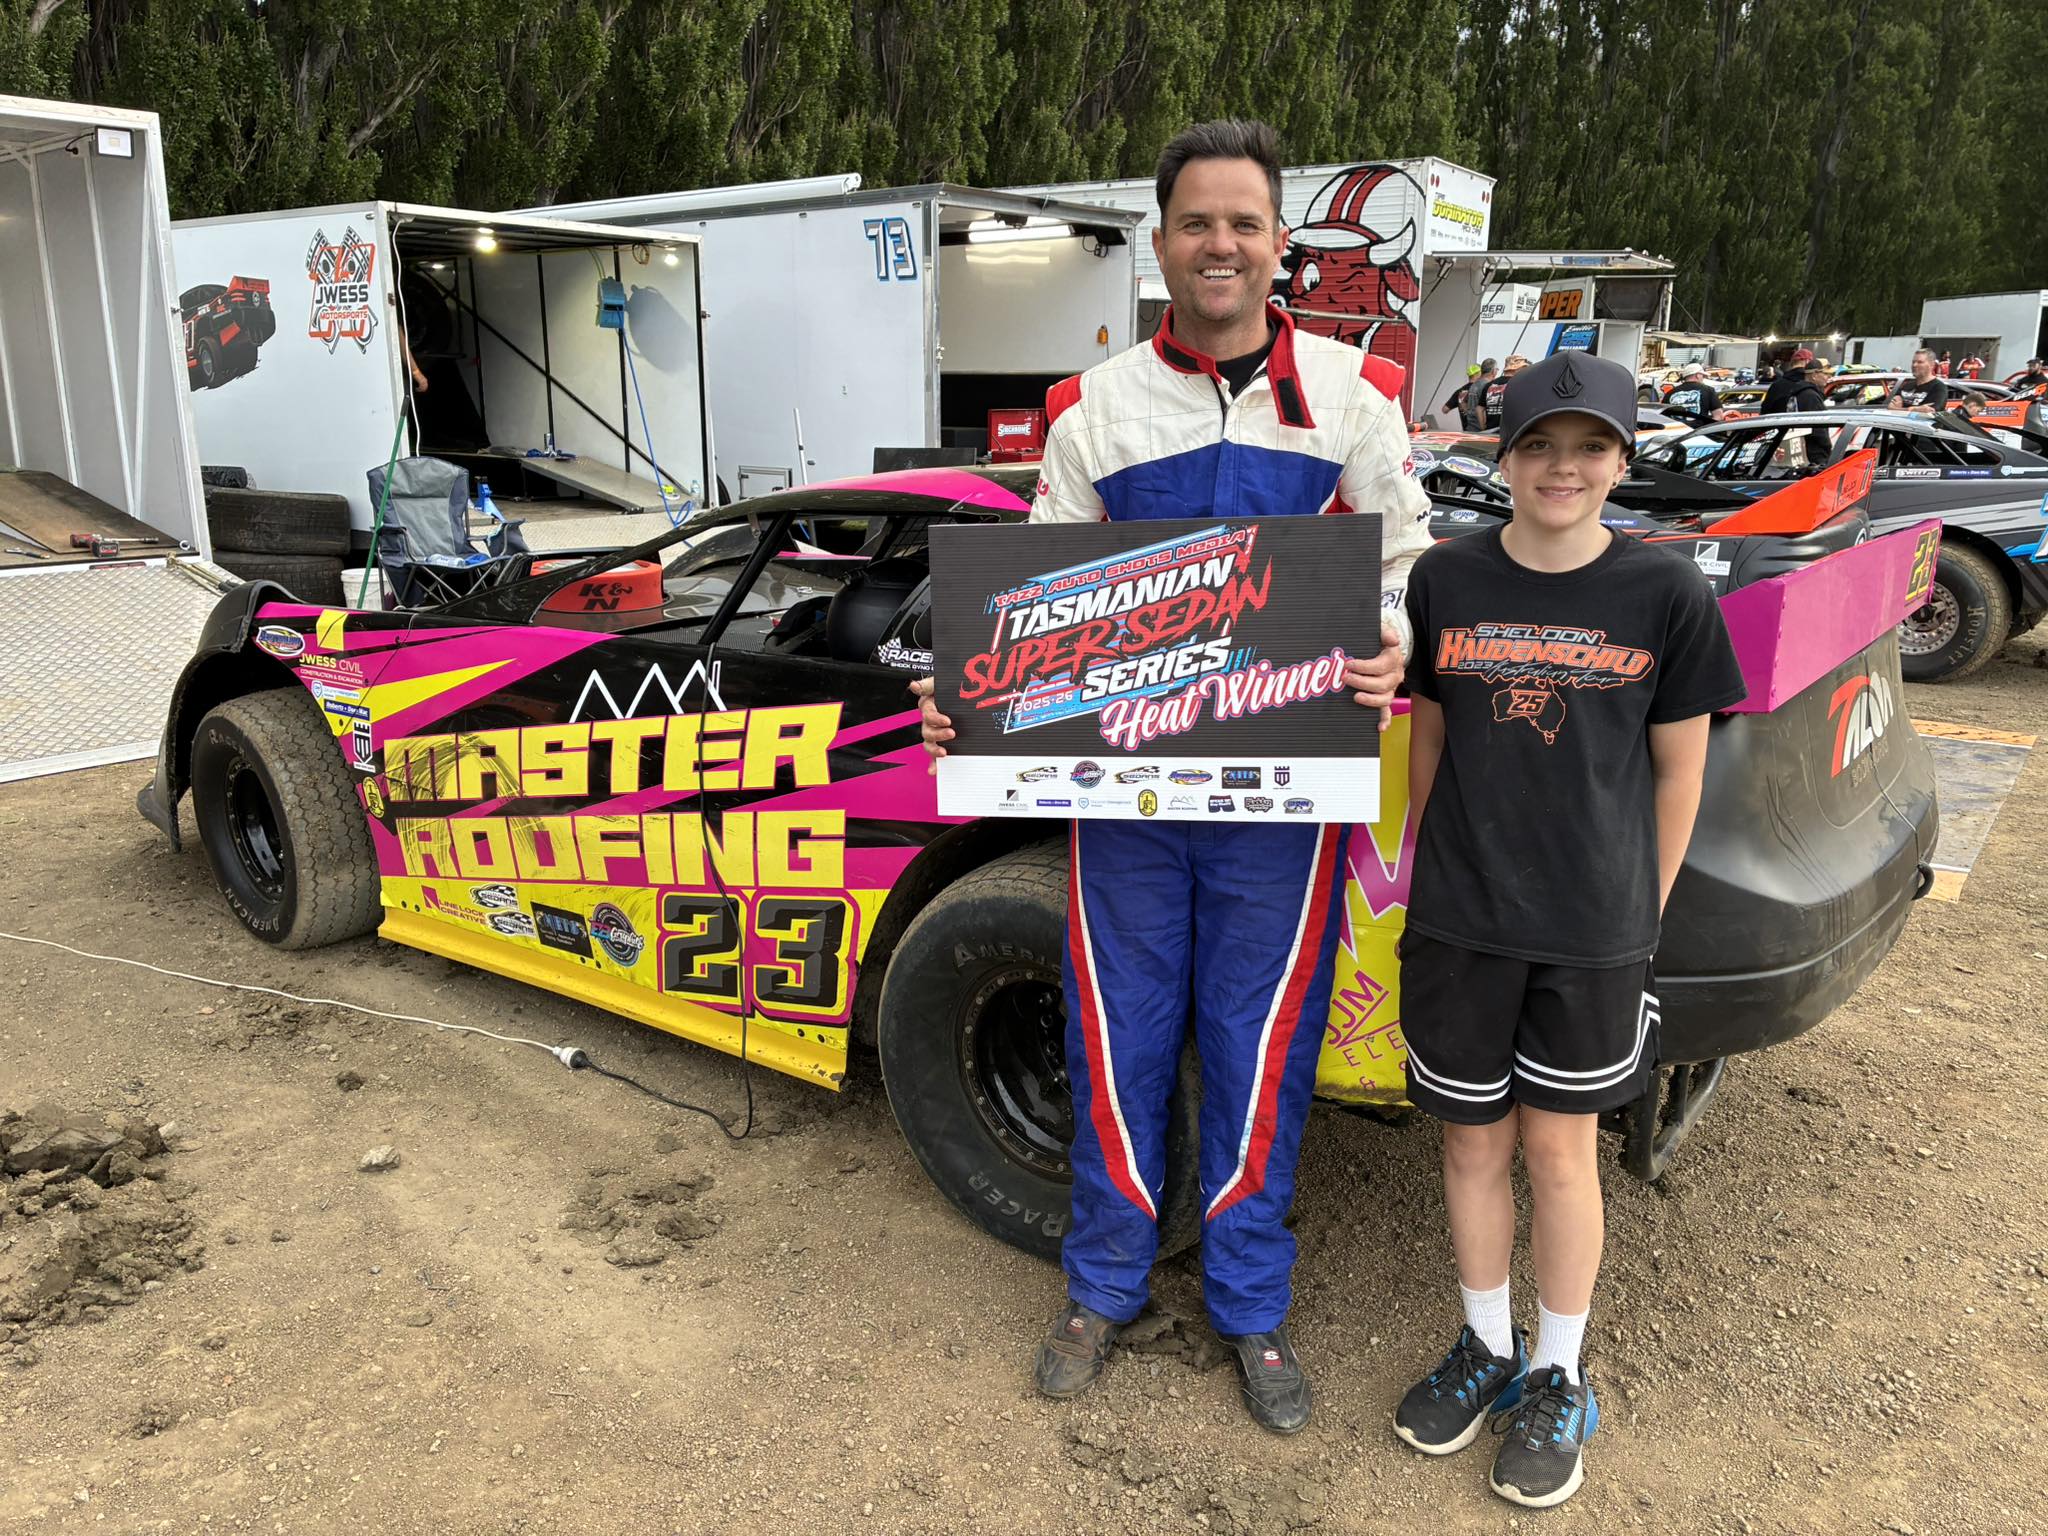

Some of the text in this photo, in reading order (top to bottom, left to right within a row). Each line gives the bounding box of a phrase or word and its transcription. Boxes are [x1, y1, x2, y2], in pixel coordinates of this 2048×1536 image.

[864, 216, 917, 281] 73
[315, 285, 369, 305] JWESS
[320, 311, 368, 320] MOTORSPORTS
[994, 530, 1246, 607] TAZZ AUTO SHOTS MEDIA
[1905, 527, 1940, 601] 23
[578, 582, 633, 597] K&
[1008, 553, 1238, 640] TASMANIAN
[582, 597, 621, 610] N
[959, 554, 1273, 699] SUPER SEDAN
[1475, 625, 1600, 645] SHELDON
[299, 653, 363, 675] JWESS CIVIL
[1439, 632, 1650, 675] HAUDENSCHILD
[300, 669, 333, 679] CONSTRUCTION
[890, 661, 930, 671] SHOCK DYNO
[1080, 636, 1233, 702] SERIES
[1457, 658, 1621, 685] 2023 Australian Tour
[1101, 648, 1350, 750] Heat Winner
[1510, 693, 1546, 713] 25
[383, 701, 845, 801] MASTER
[396, 810, 846, 888] ROOFING
[481, 893, 517, 906] SEDANS
[440, 908, 488, 926] CREATIVE
[496, 918, 535, 934] SEDANS
[663, 894, 846, 1009] 23
